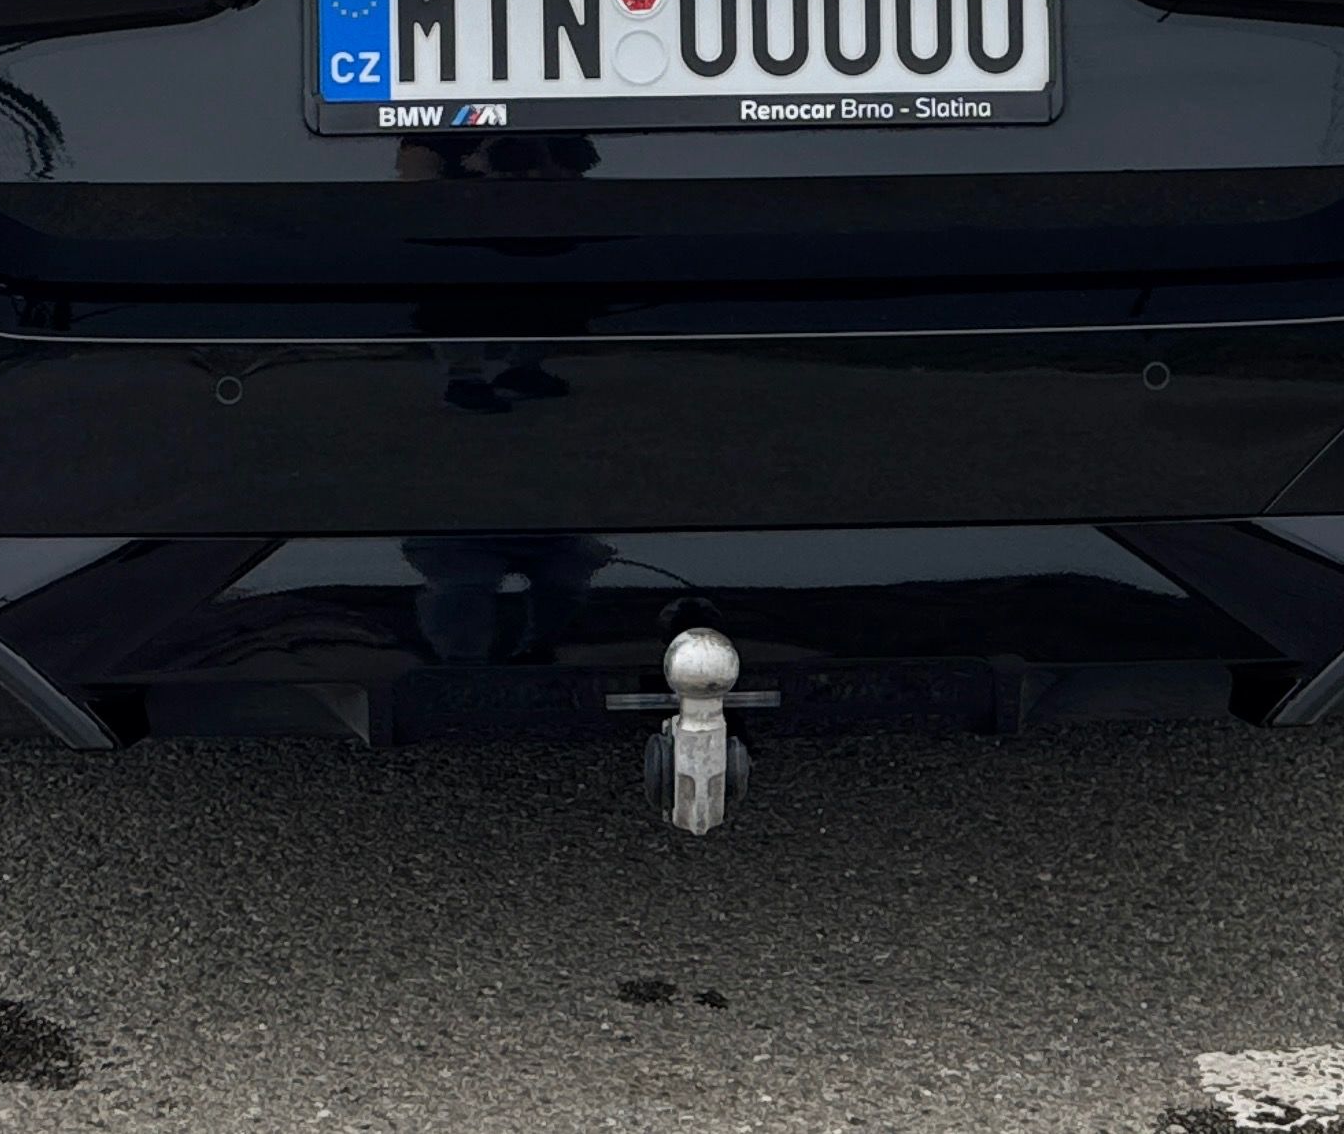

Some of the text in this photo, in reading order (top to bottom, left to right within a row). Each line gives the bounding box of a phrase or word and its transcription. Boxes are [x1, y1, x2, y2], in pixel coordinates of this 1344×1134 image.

[330, 51, 381, 83] CZ
[378, 106, 444, 127] BMW
[740, 100, 836, 120] Renocar
[841, 98, 894, 119] Brno
[915, 97, 991, 118] Slatina
